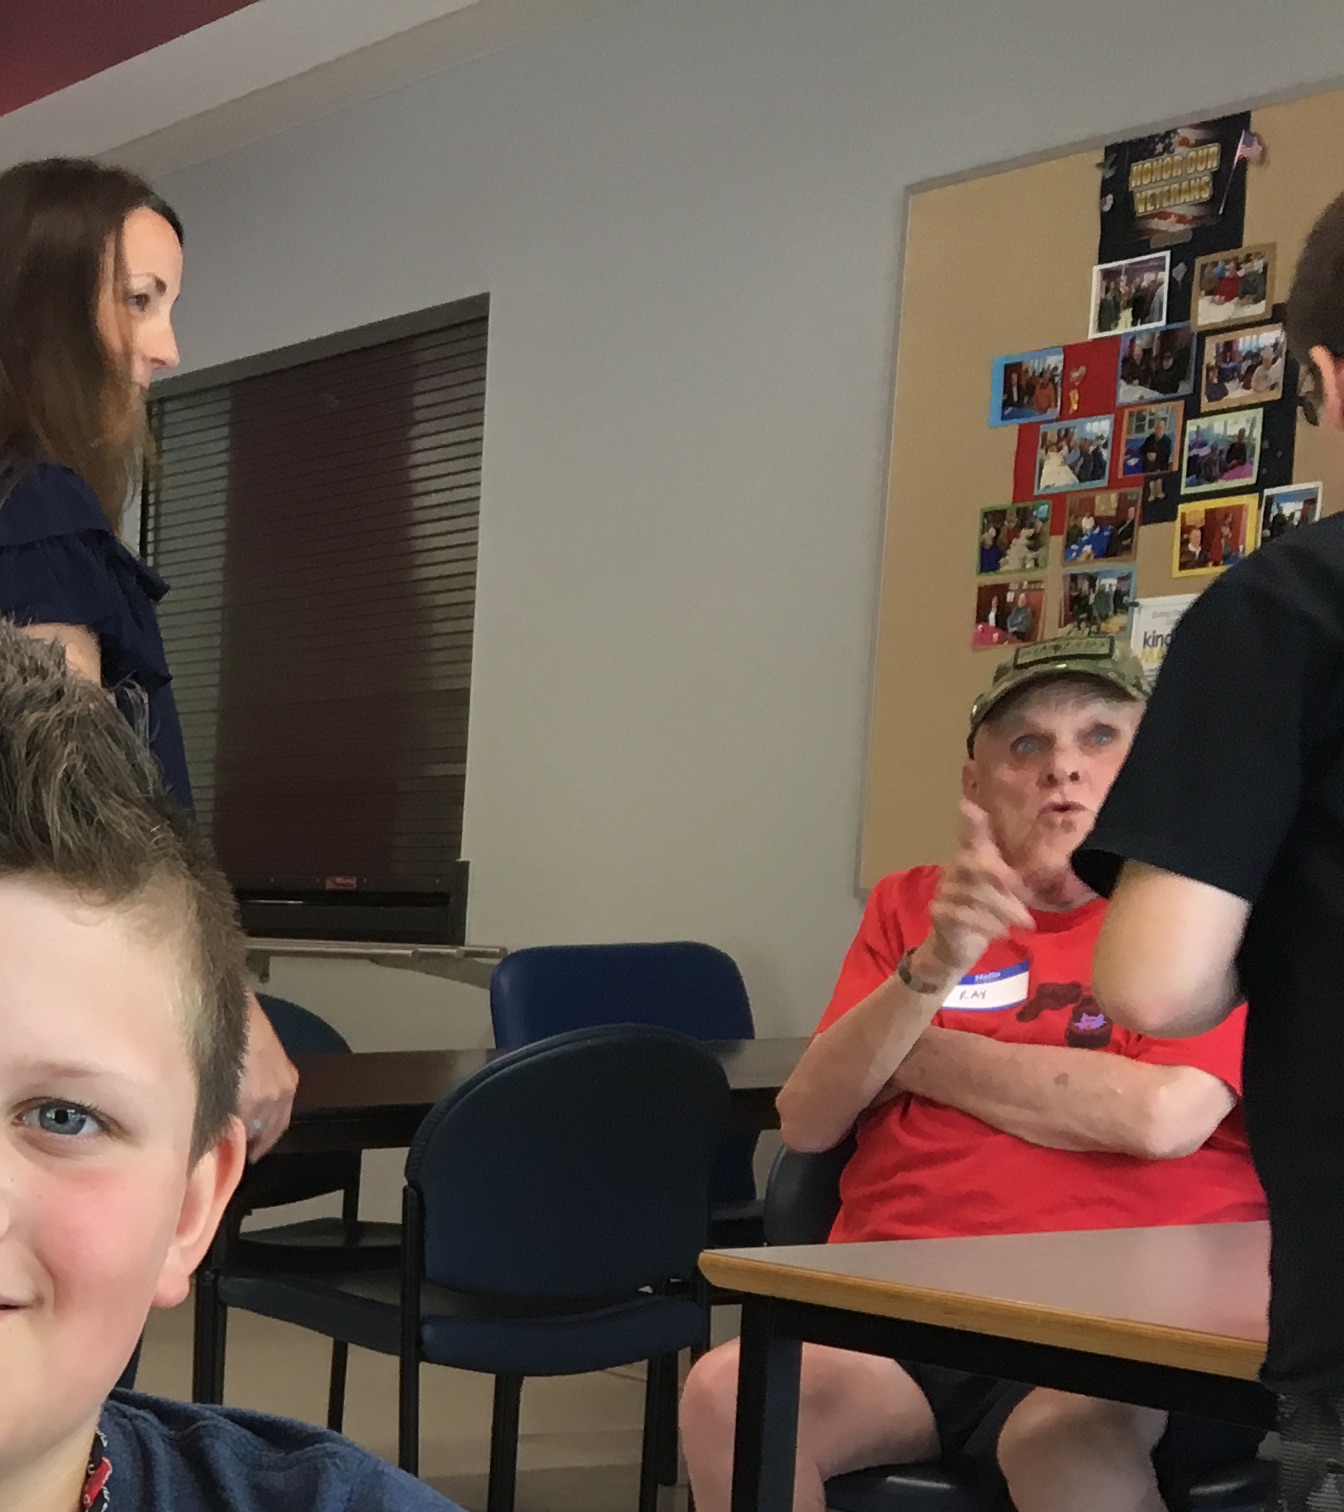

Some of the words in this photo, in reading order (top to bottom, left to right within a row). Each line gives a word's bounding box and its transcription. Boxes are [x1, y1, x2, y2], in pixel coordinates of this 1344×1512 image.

[1131, 155, 1183, 188] HONOR
[1186, 146, 1219, 174] OUR
[1136, 176, 1211, 213] VETERANS
